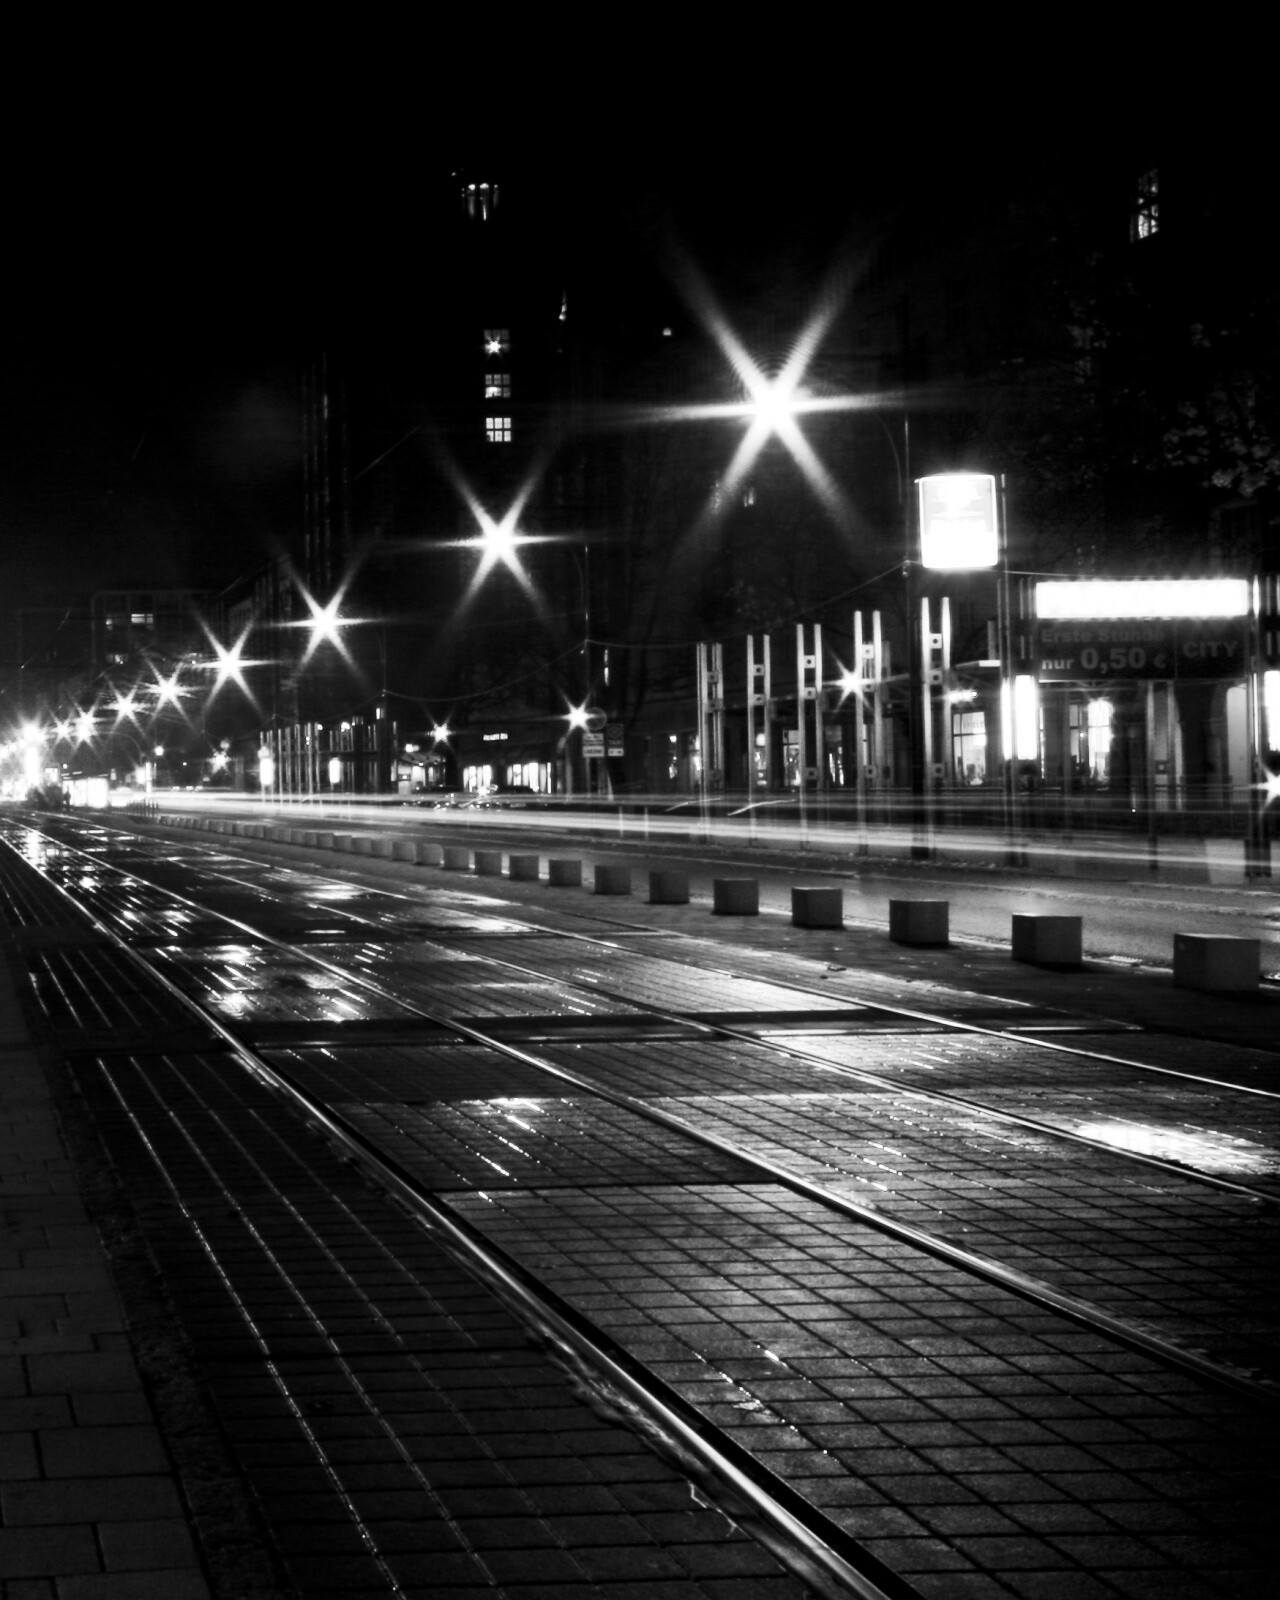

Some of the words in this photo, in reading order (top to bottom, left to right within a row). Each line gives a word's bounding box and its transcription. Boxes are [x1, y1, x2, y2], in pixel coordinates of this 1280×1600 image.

[1182, 640, 1238, 658] CITY
[1041, 658, 1074, 670] nur
[1081, 647, 1146, 674] 0,50
